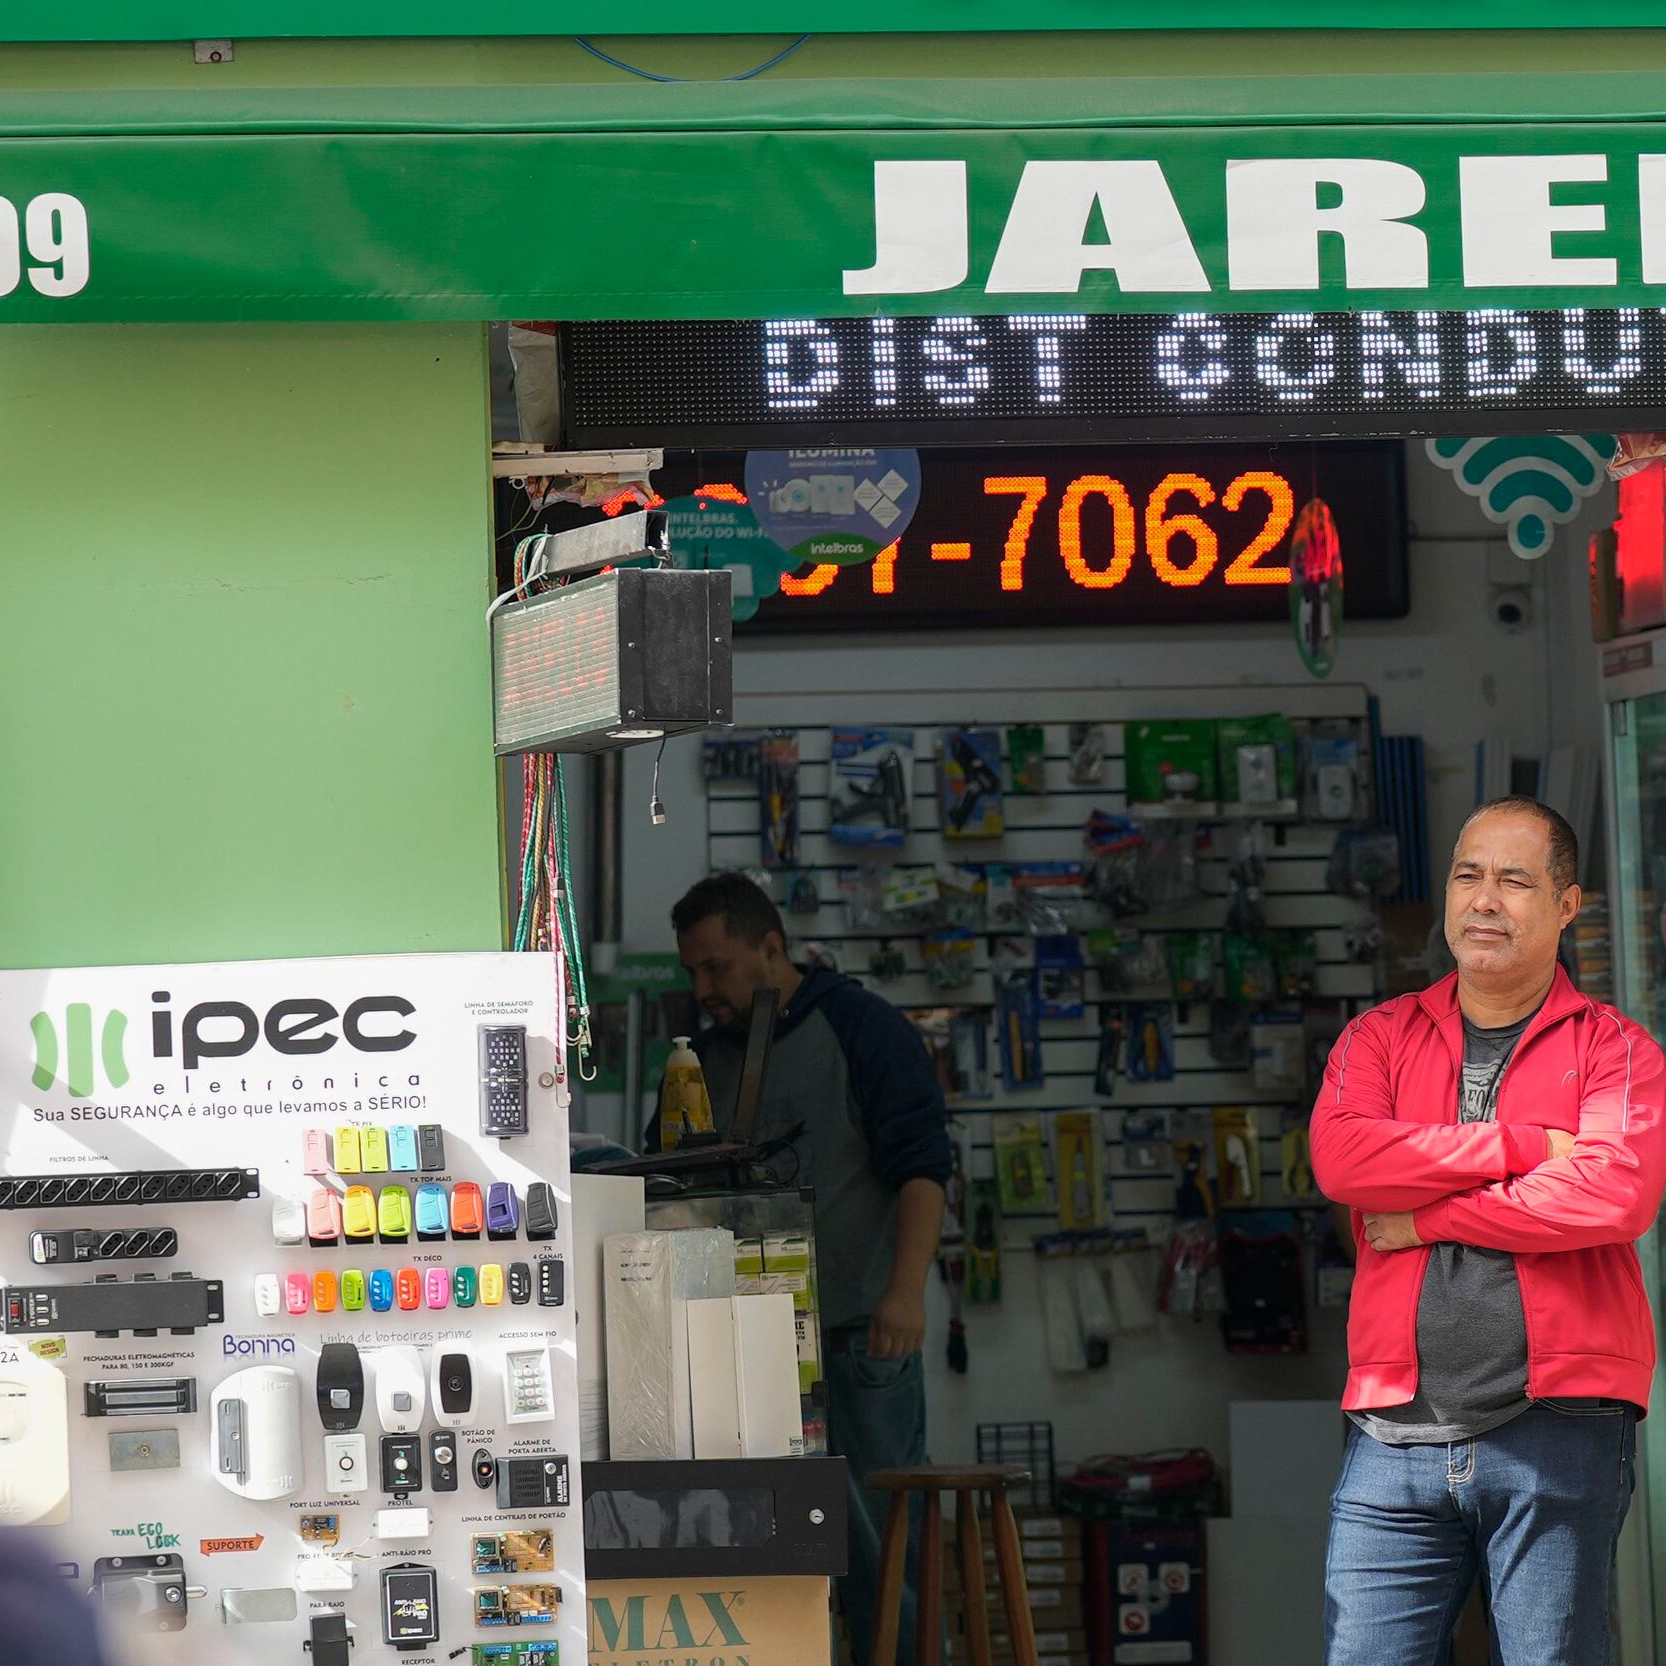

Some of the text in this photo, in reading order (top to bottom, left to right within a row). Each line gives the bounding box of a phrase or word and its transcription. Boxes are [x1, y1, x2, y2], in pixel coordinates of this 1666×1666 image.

[766, 316, 1087, 408] DIST
[810, 542, 864, 555] intelbras
[151, 990, 417, 1069] ipec
[153, 1072, 420, 1095] eletrônica
[33, 1093, 427, 1126] Sua SEGURANÇA é algo que levamos a SÉRIO!
[539, 1252, 564, 1260] CANAIS
[320, 1329, 472, 1345] Linha de botoeiras prime
[222, 1335, 295, 1355] Bonna
[0, 1351, 20, 1364] 2A
[83, 1351, 195, 1362] FECHADURAS ELETROMAGNÉTICAS
[462, 1428, 495, 1437] BOTÃO DE
[467, 1435, 493, 1444] PÂNICO
[290, 1501, 308, 1509] PORT
[387, 1499, 414, 1507] PROTEL
[462, 1515, 482, 1523] LINHA
[483, 1514, 493, 1522] DE
[495, 1513, 528, 1521] CENTRAIS
[539, 1511, 566, 1520] PORTÃO
[206, 1540, 255, 1551] SUPORTE
[588, 1590, 751, 1653] MAX
[400, 1658, 436, 1666] RECEPTOR
